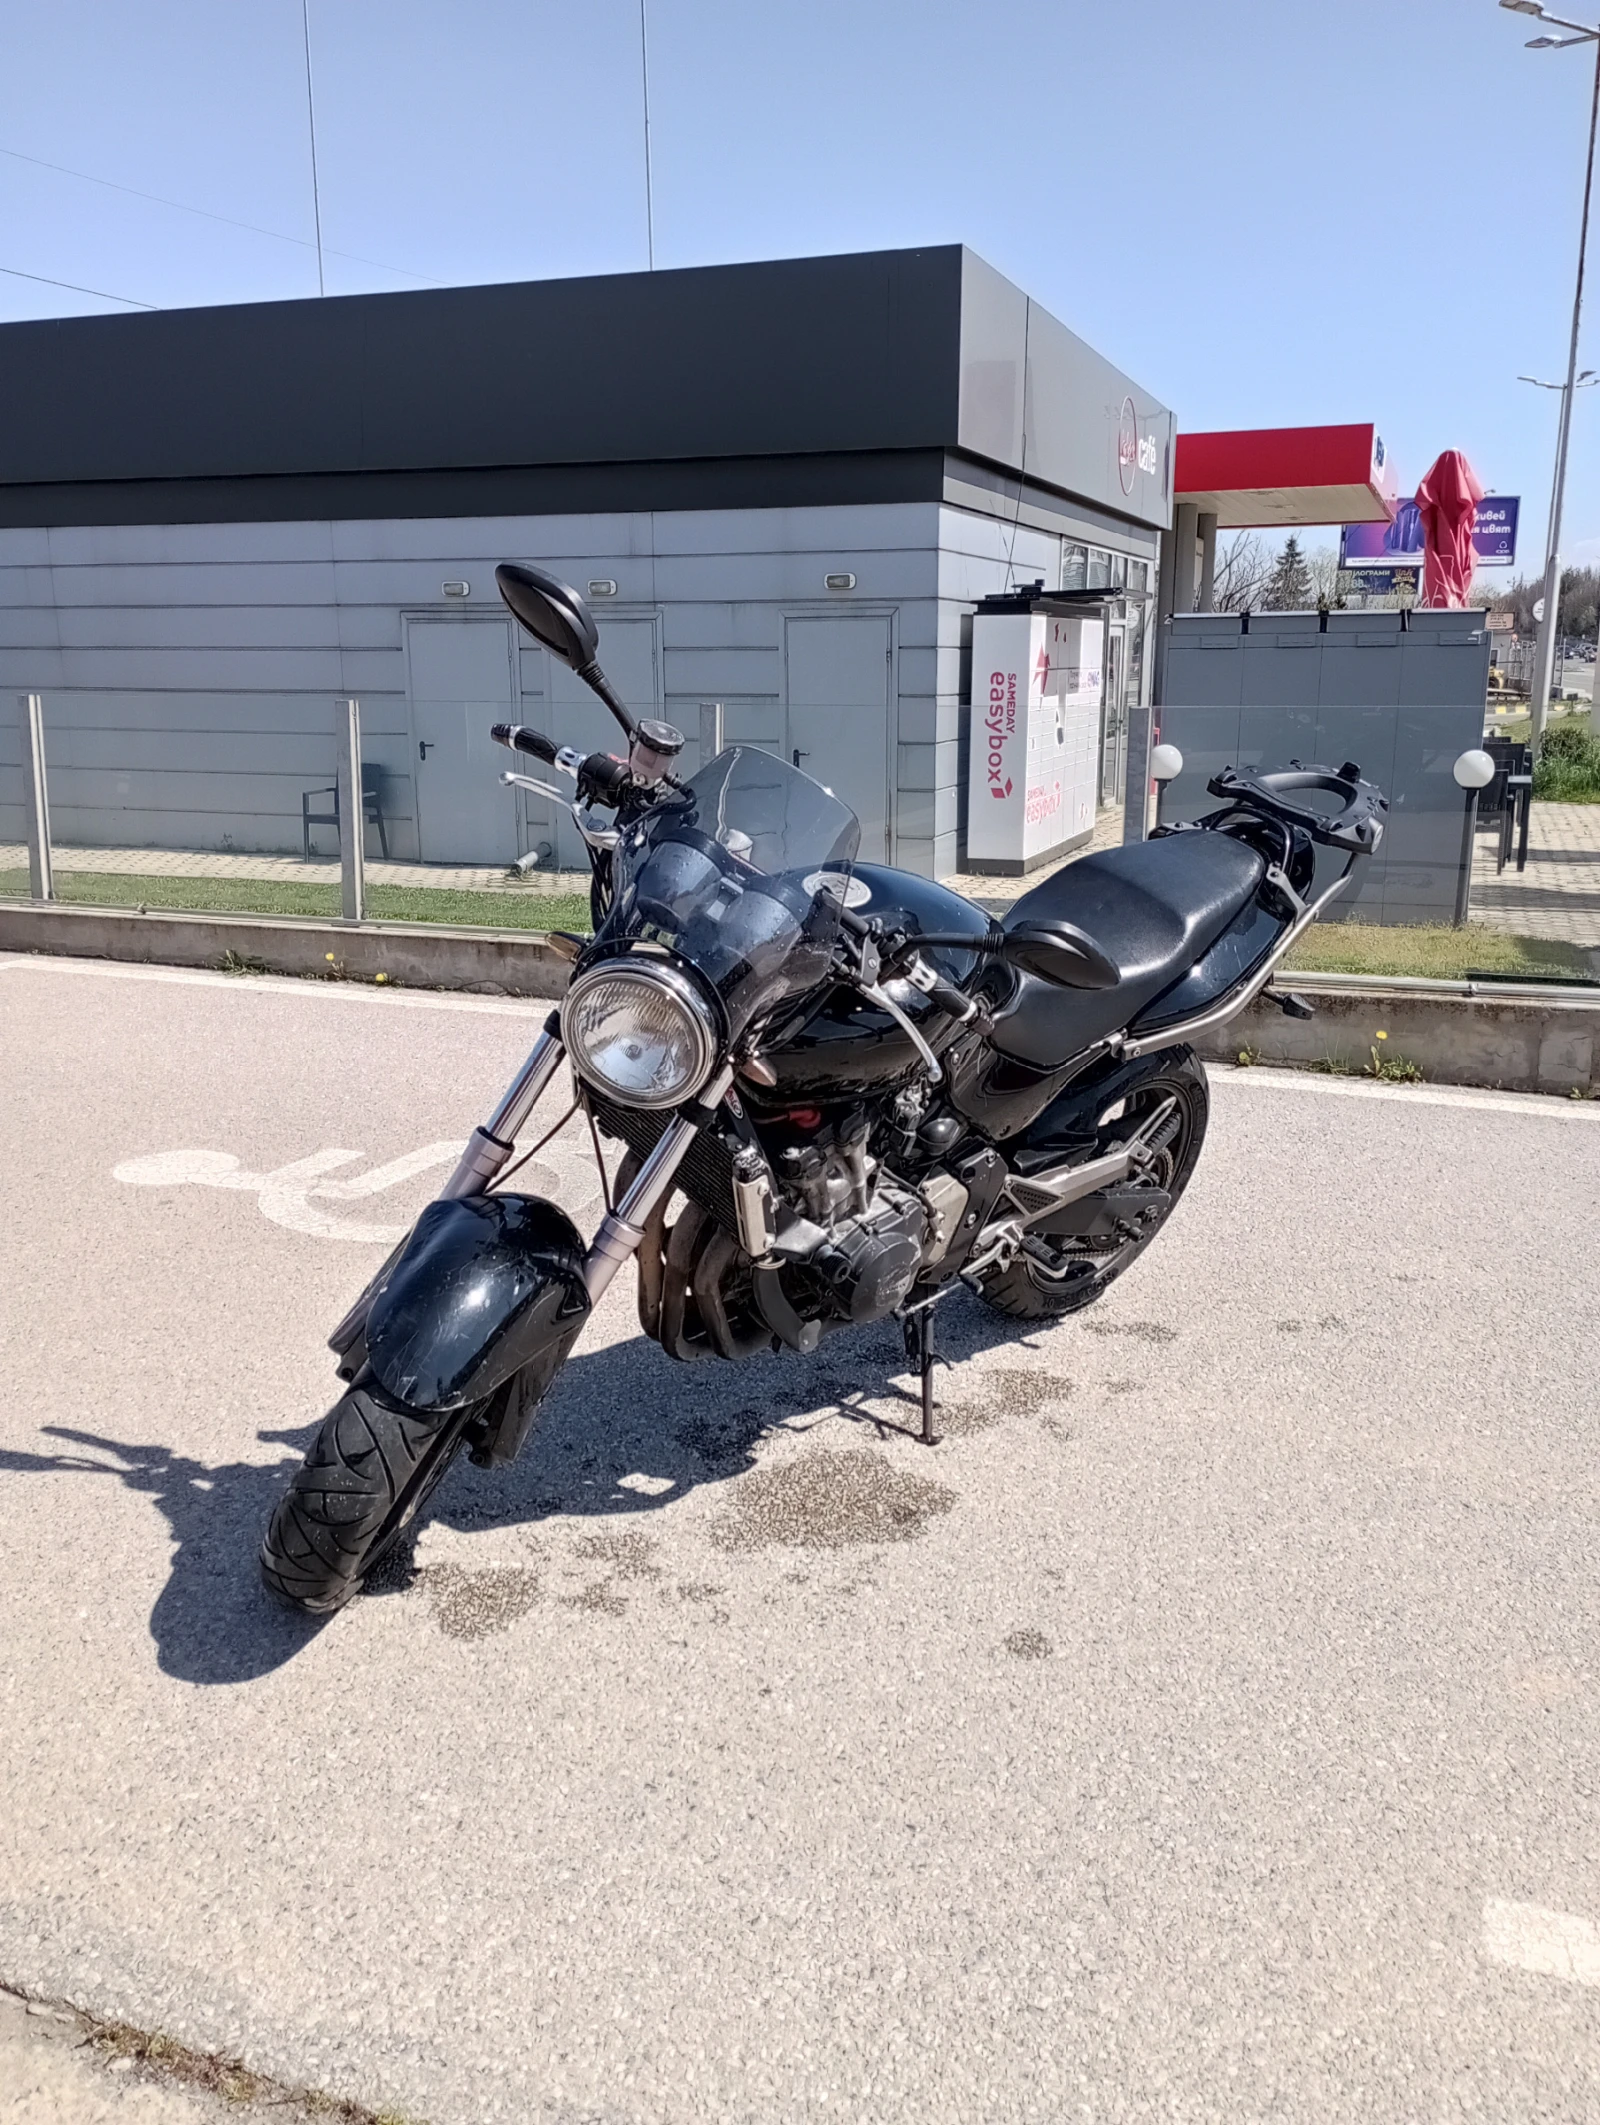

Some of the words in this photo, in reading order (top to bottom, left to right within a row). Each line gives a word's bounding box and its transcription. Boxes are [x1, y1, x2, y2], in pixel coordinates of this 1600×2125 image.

[1138, 435, 1156, 475] café
[1481, 523, 1511, 534] цвят
[984, 671, 1008, 783] easybox
[1006, 673, 1016, 734] SAMEDAY
